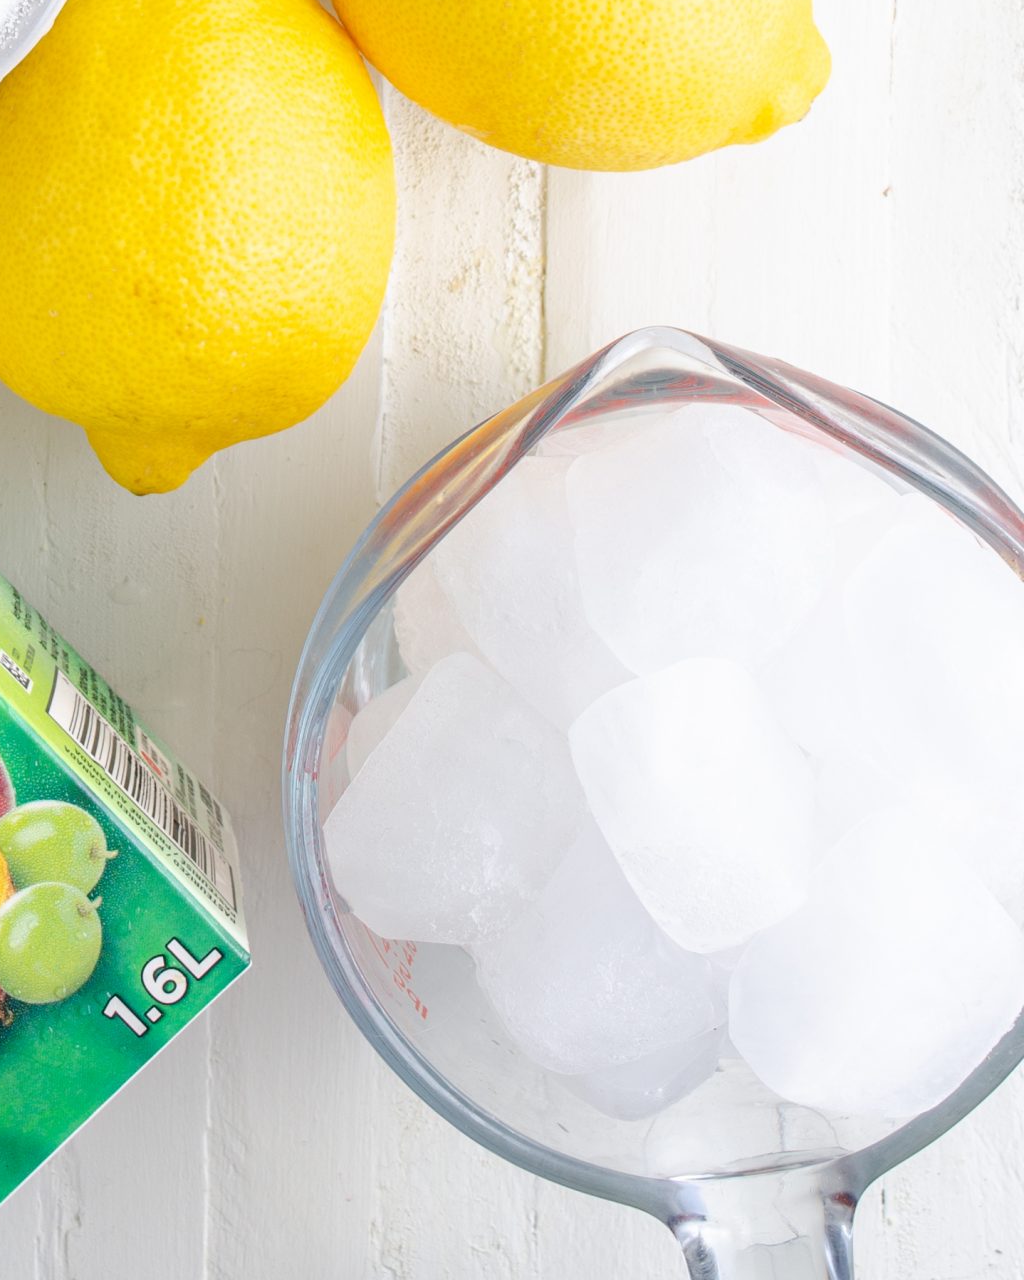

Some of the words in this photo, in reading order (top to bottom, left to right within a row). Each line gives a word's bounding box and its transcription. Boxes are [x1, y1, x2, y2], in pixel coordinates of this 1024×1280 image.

[64, 744, 103, 786] CANADA
[74, 749, 114, 790] CANADA
[103, 782, 117, 797] IN
[114, 789, 127, 805] AU
[102, 935, 225, 1039] 1.6L
